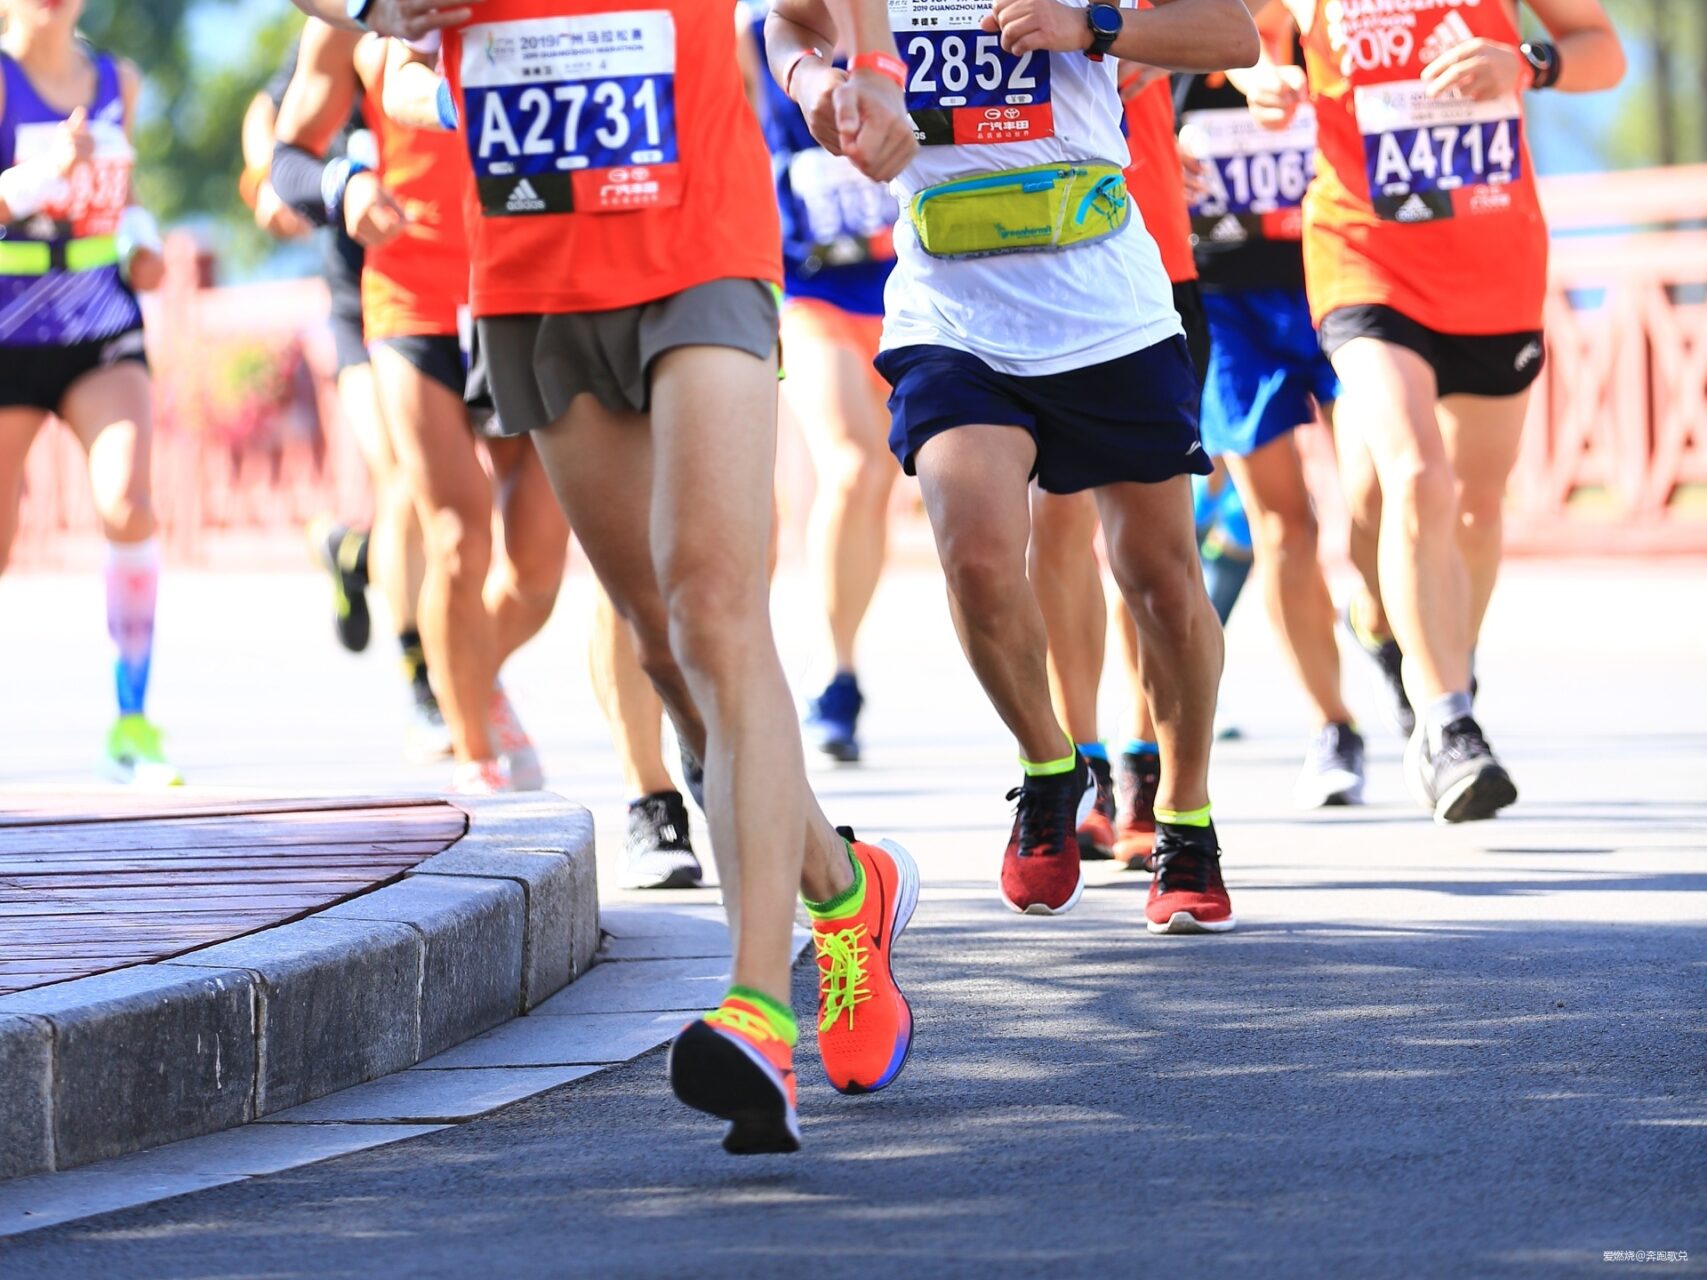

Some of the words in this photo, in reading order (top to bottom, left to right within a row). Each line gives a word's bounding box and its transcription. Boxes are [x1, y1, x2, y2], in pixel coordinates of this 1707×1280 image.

[929, 3, 976, 11] GUANGZHOU
[478, 78, 661, 158] A2731
[977, 120, 1030, 131] 广汽丰田
[1374, 118, 1515, 186] A4714
[506, 200, 546, 211] adidas
